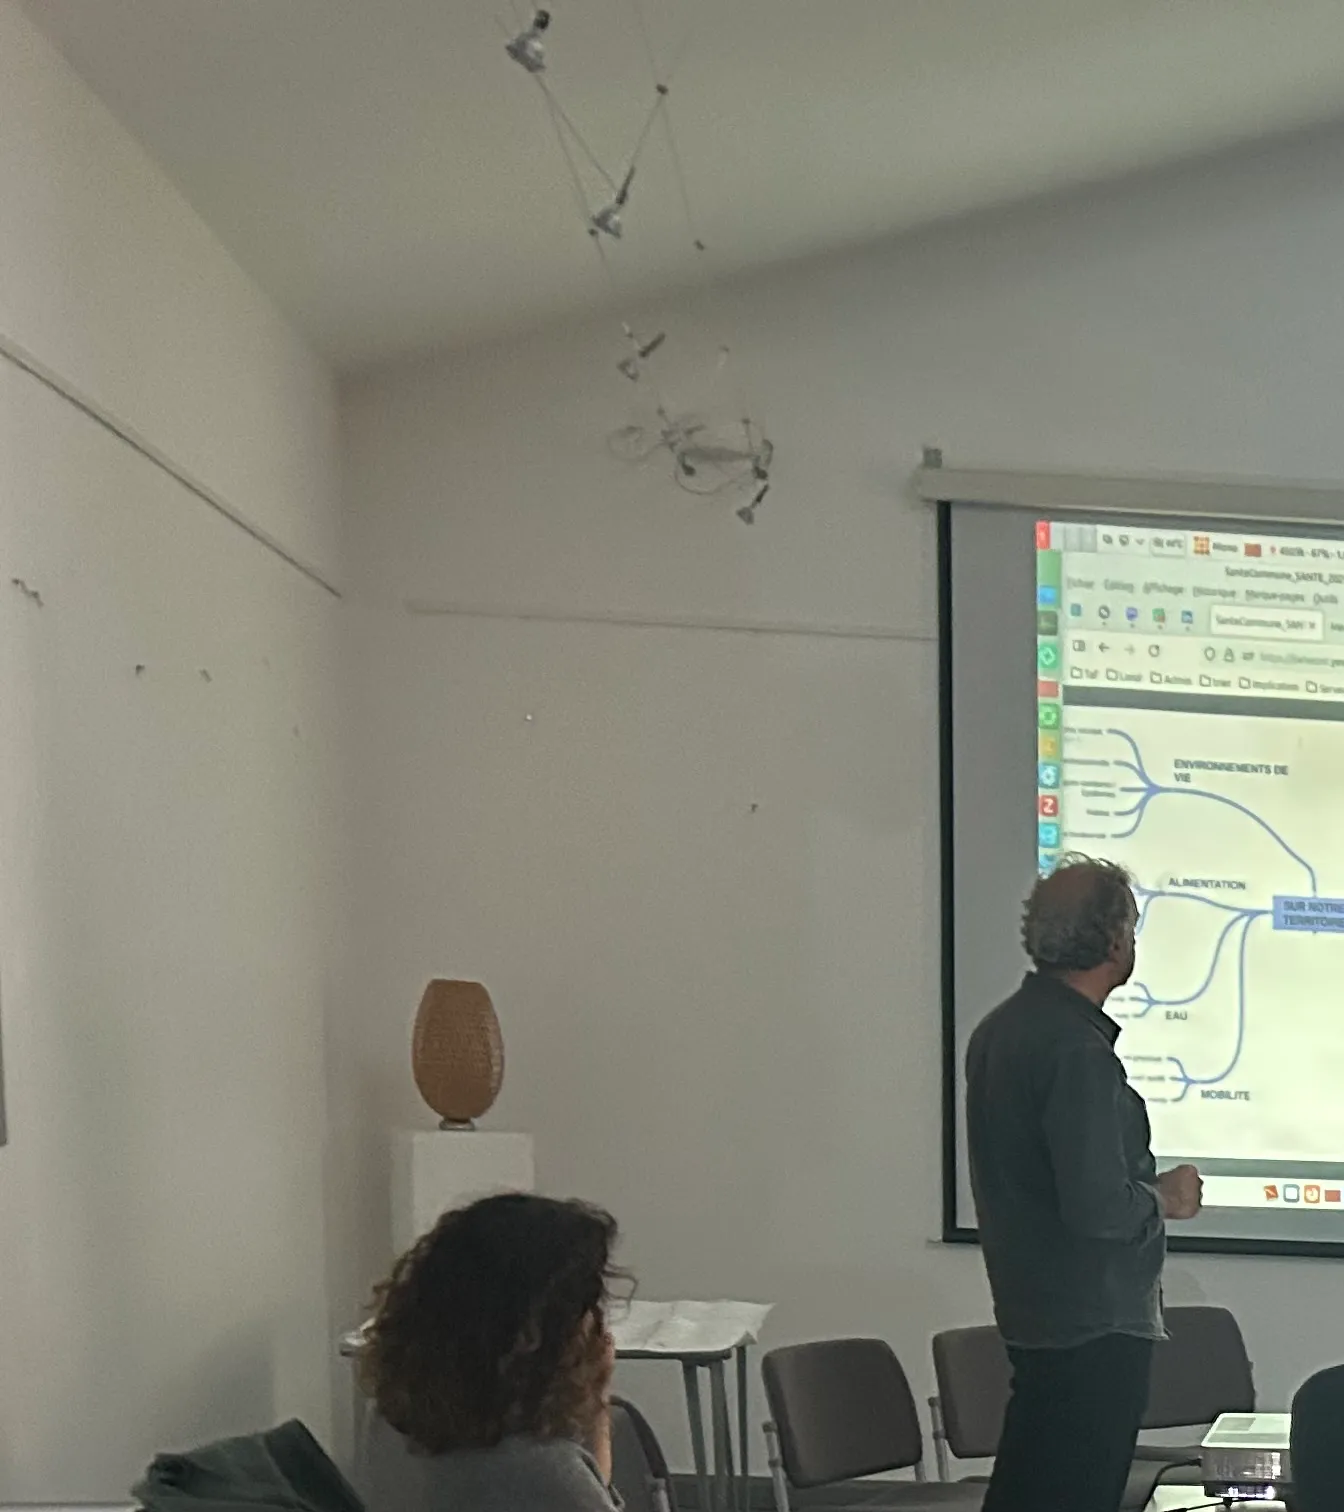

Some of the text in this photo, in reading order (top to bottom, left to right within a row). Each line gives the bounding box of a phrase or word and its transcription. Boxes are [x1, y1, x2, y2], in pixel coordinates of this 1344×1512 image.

[1274, 764, 1289, 776] DE
[1173, 773, 1192, 783] VIE
[1168, 877, 1246, 891] ALIMENTATION
[1166, 1011, 1188, 1021] EAU
